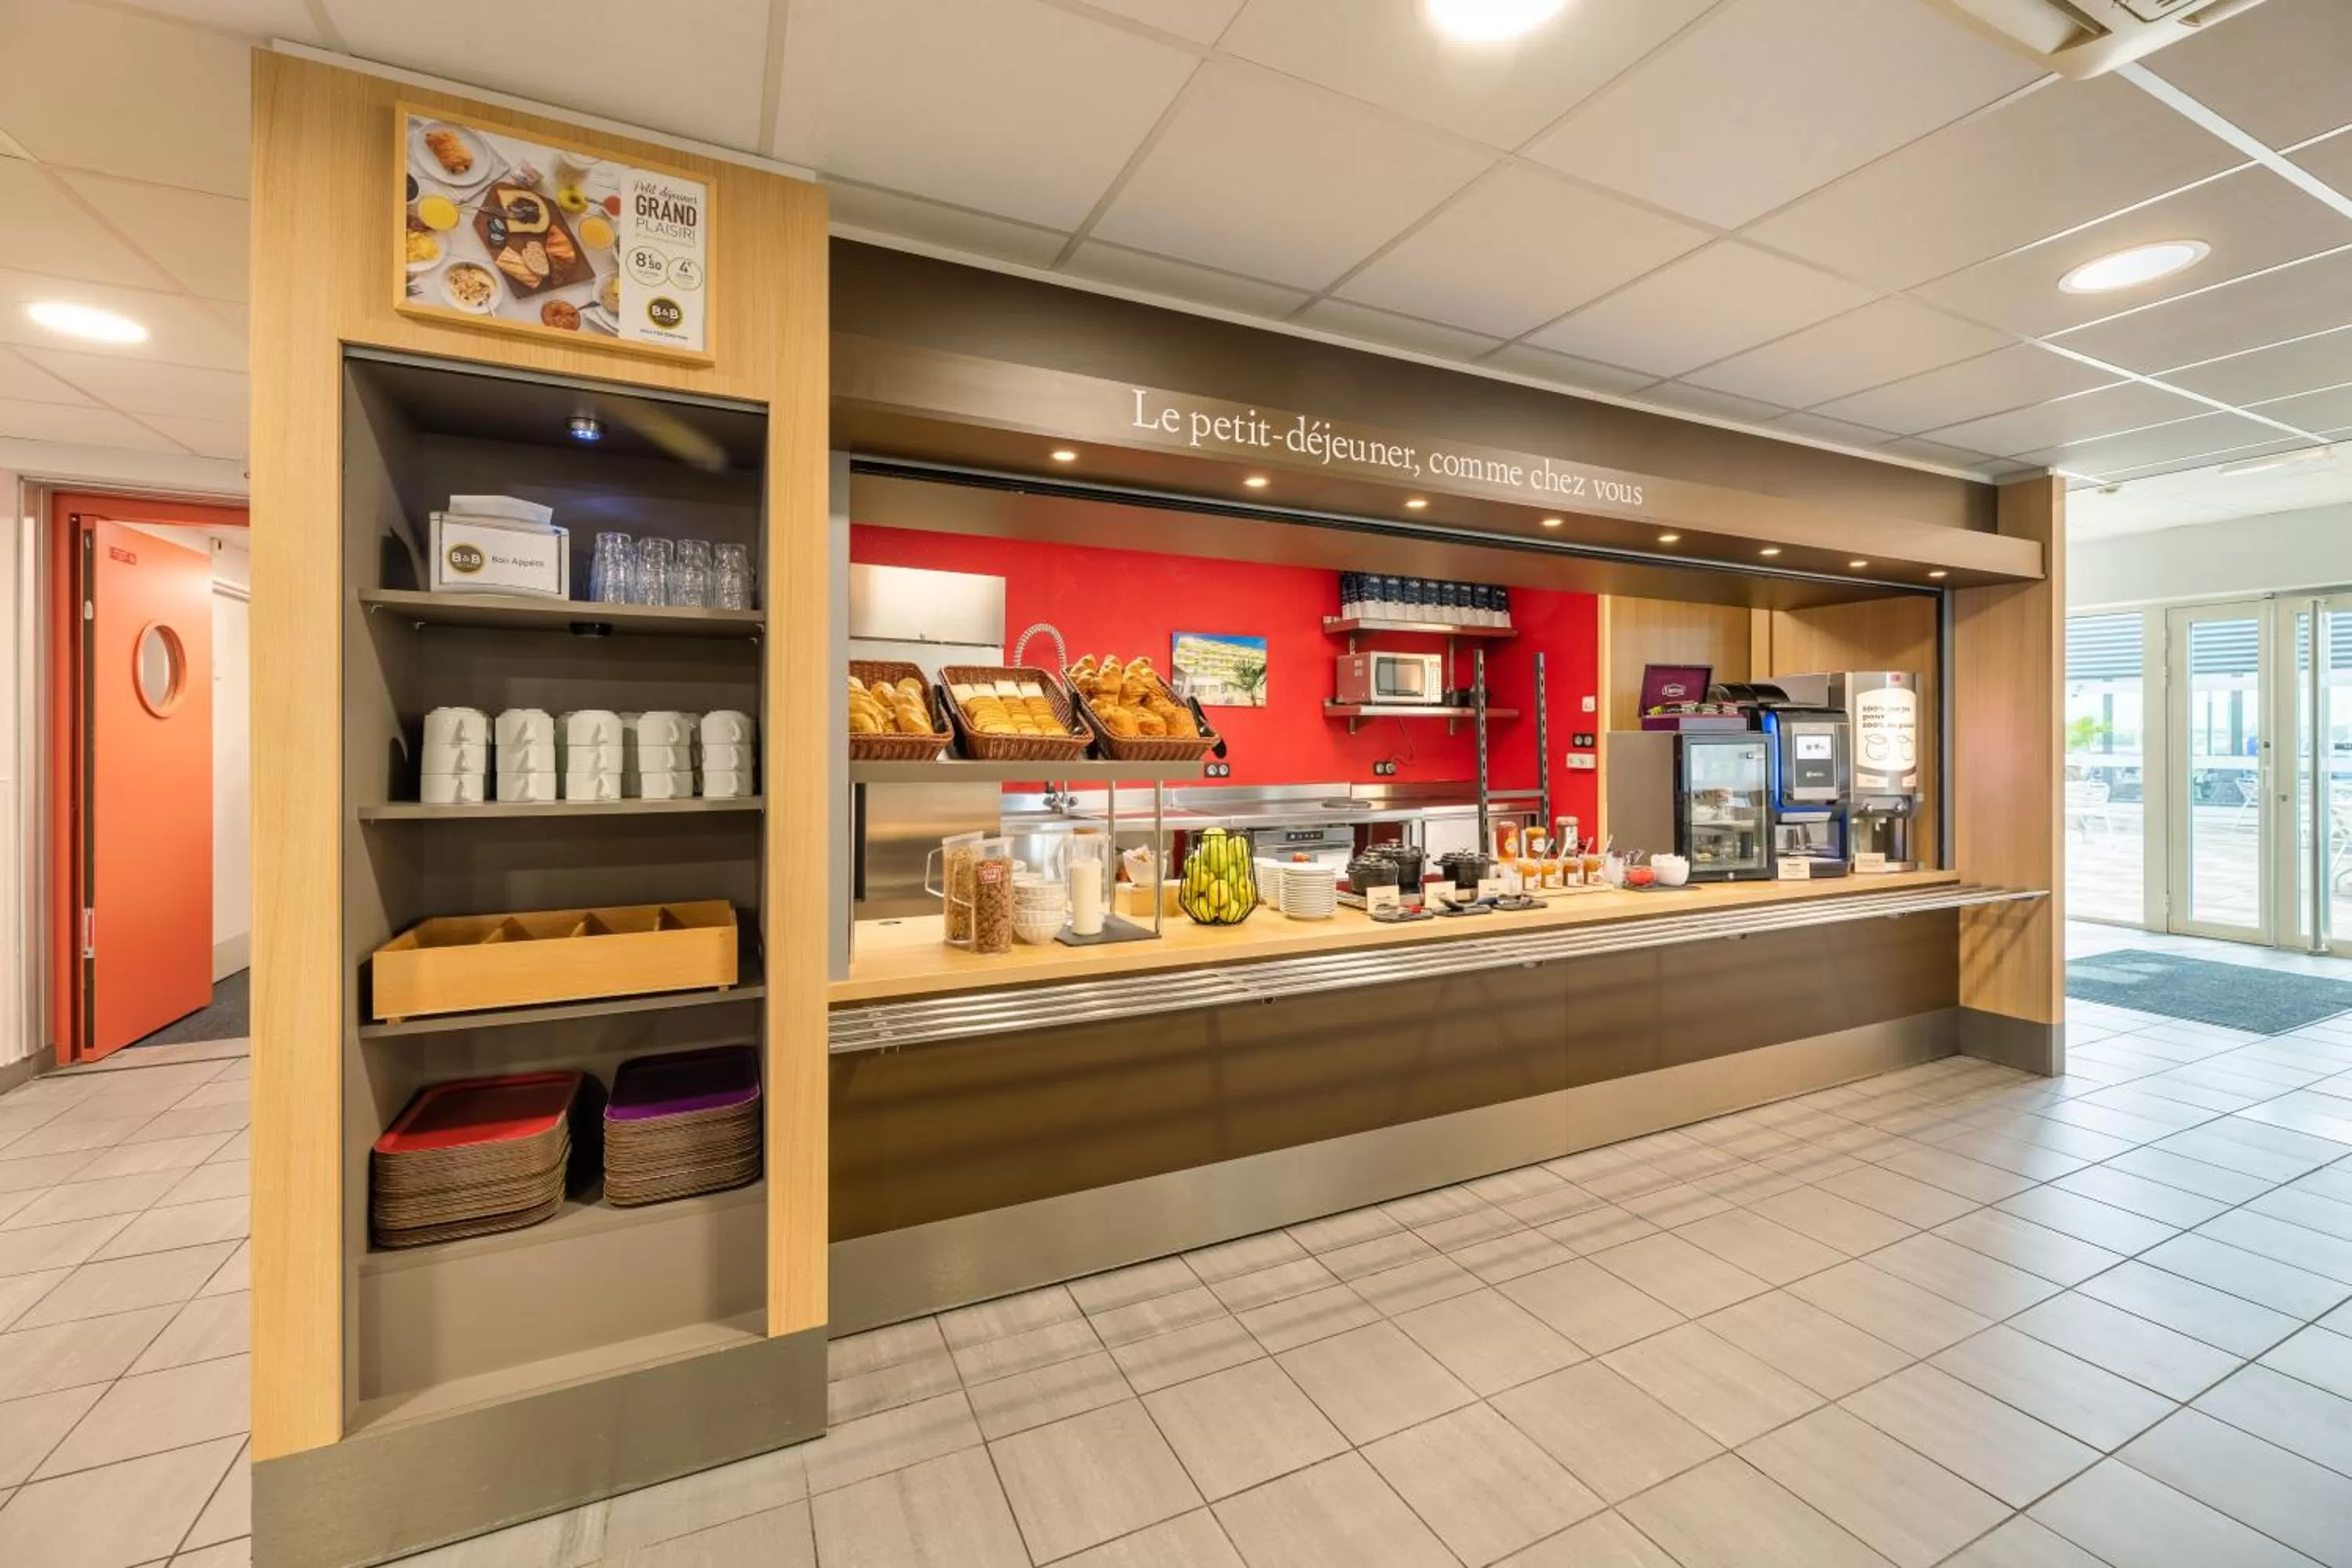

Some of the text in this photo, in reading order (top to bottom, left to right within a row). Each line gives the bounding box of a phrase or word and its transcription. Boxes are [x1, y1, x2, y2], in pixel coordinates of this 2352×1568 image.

[636, 194, 696, 227] GRAND
[652, 305, 679, 319] B&B
[1132, 388, 1643, 506] Le petit-déjeuner, comme chez vous
[452, 551, 481, 564] B&B
